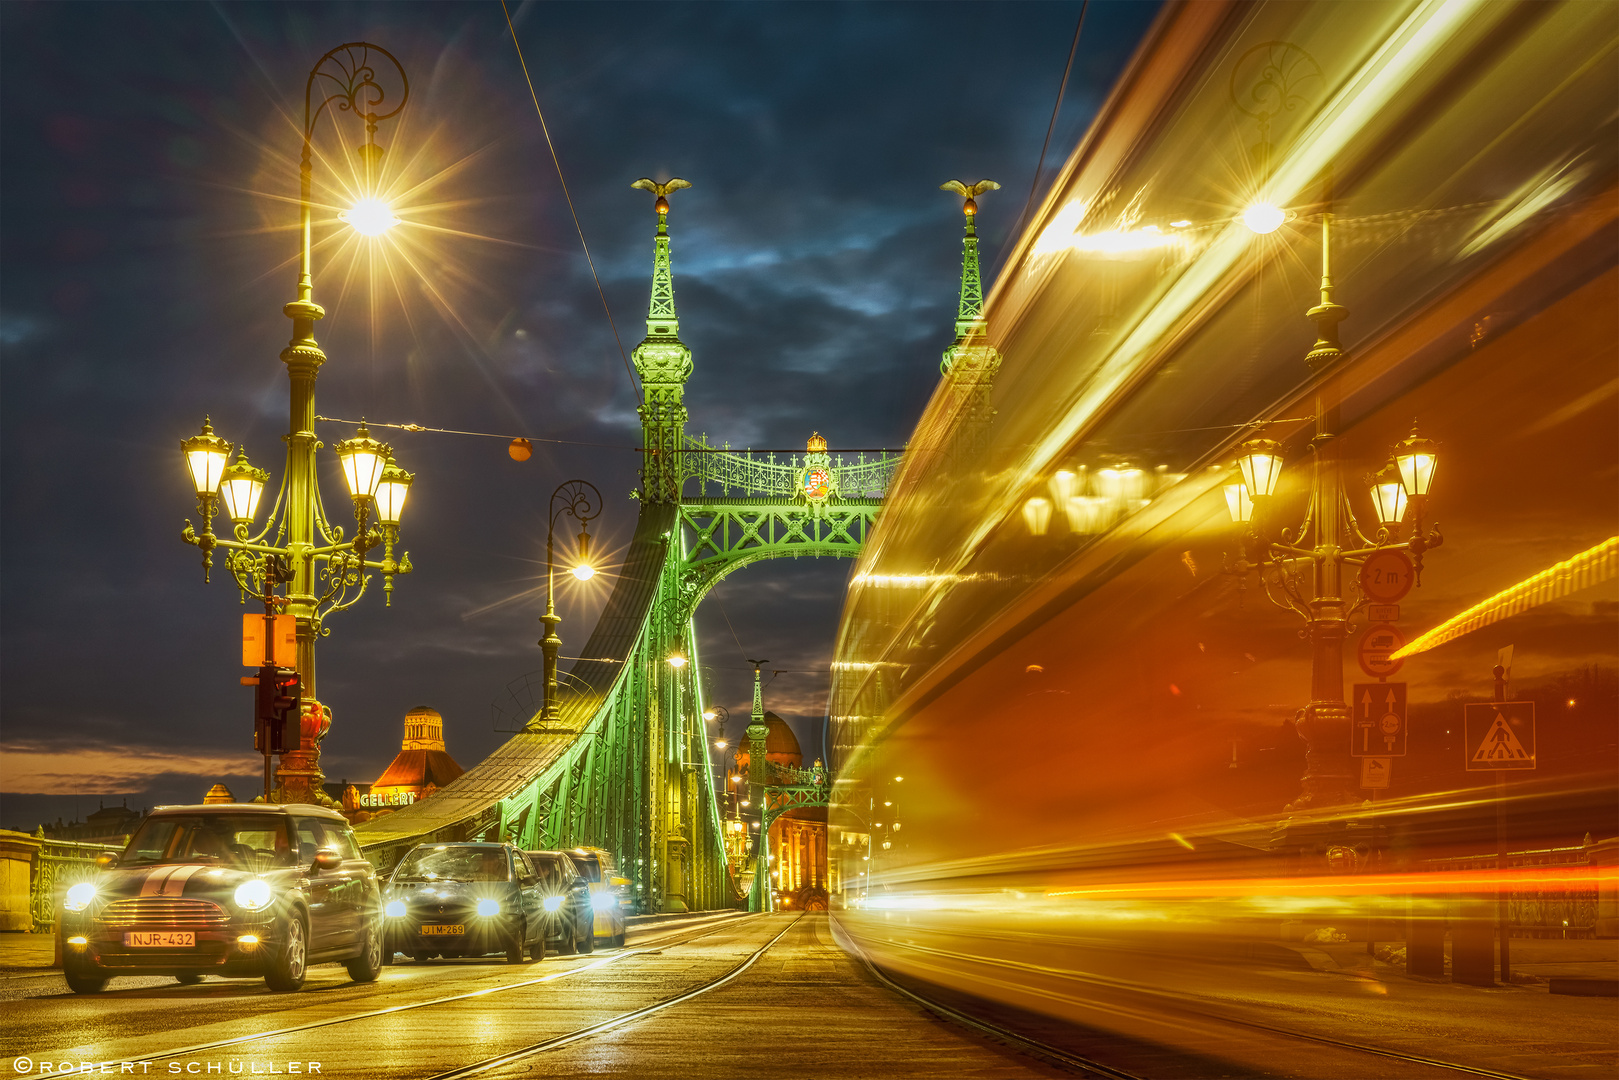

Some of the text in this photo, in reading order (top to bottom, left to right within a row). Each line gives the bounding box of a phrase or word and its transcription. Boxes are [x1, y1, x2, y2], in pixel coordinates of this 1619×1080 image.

[1374, 568, 1398, 584] 2 m
[423, 925, 464, 934] JIM-269
[133, 933, 193, 945] NJR-432
